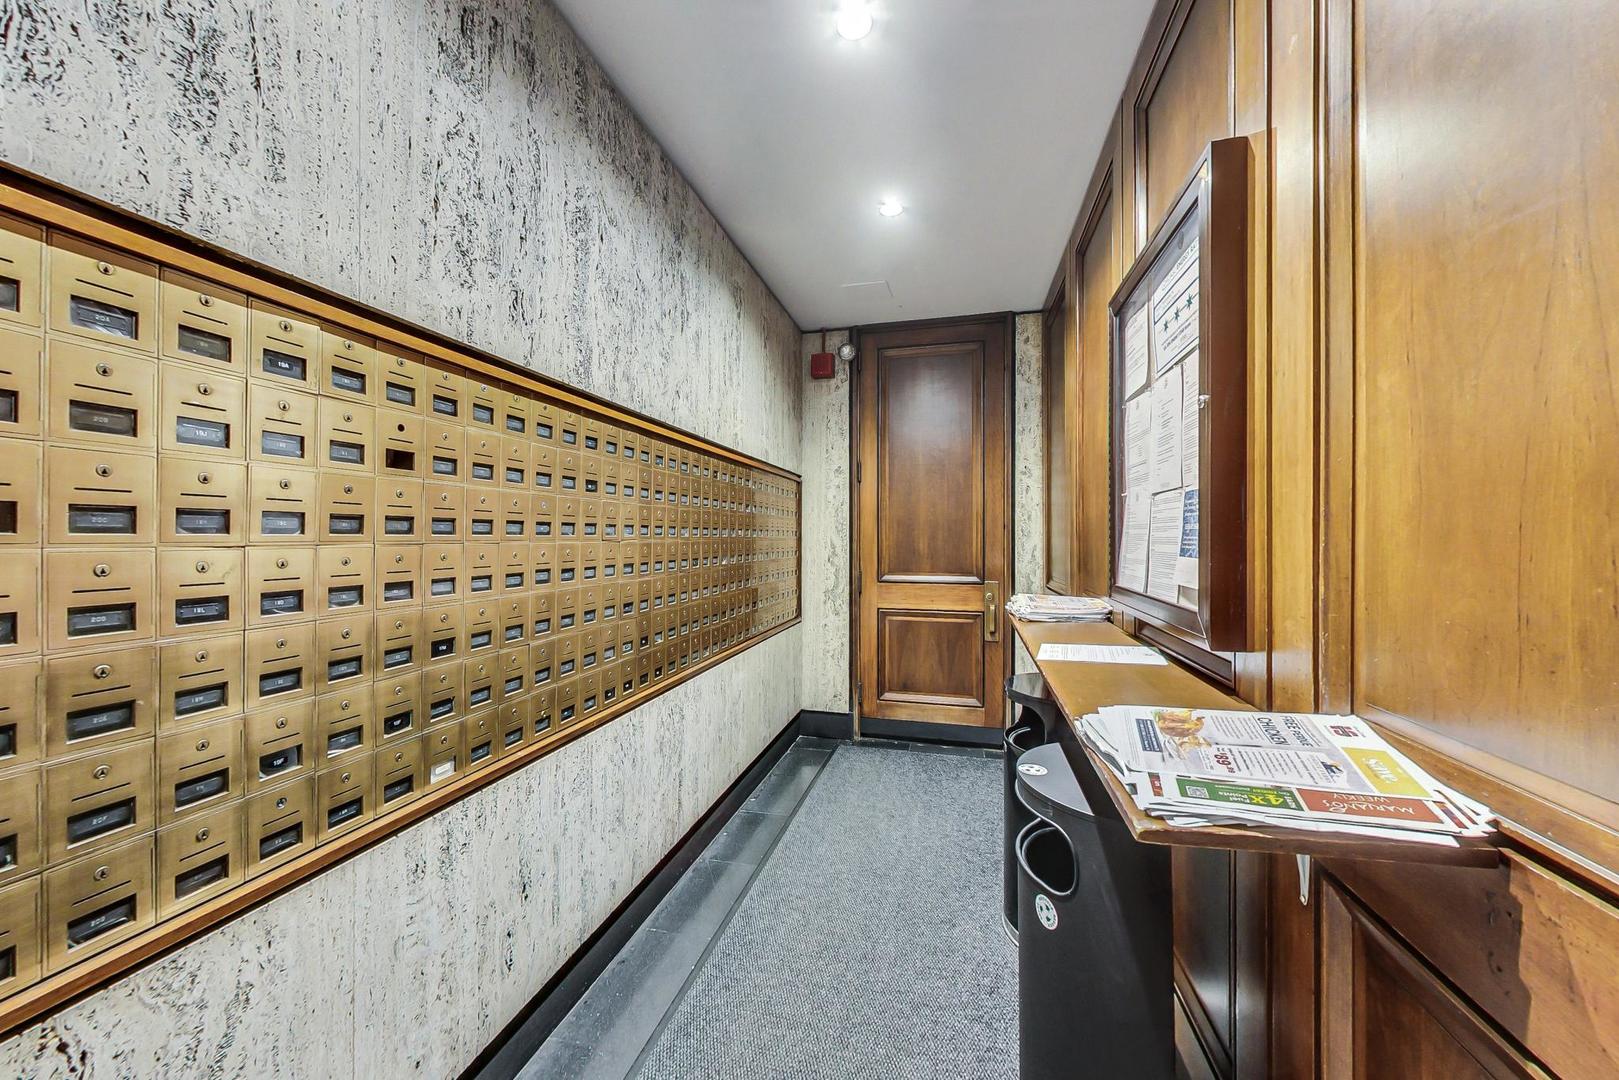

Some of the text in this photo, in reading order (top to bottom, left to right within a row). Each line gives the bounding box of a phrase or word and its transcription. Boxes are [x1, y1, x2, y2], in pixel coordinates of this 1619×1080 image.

[95, 314, 110, 322] 20A
[1280, 716, 1302, 730] FREE
[1257, 717, 1290, 745] CHICKEN
[1333, 793, 1390, 802] WEEKLY
[1322, 799, 1415, 815] MARIANO'S
